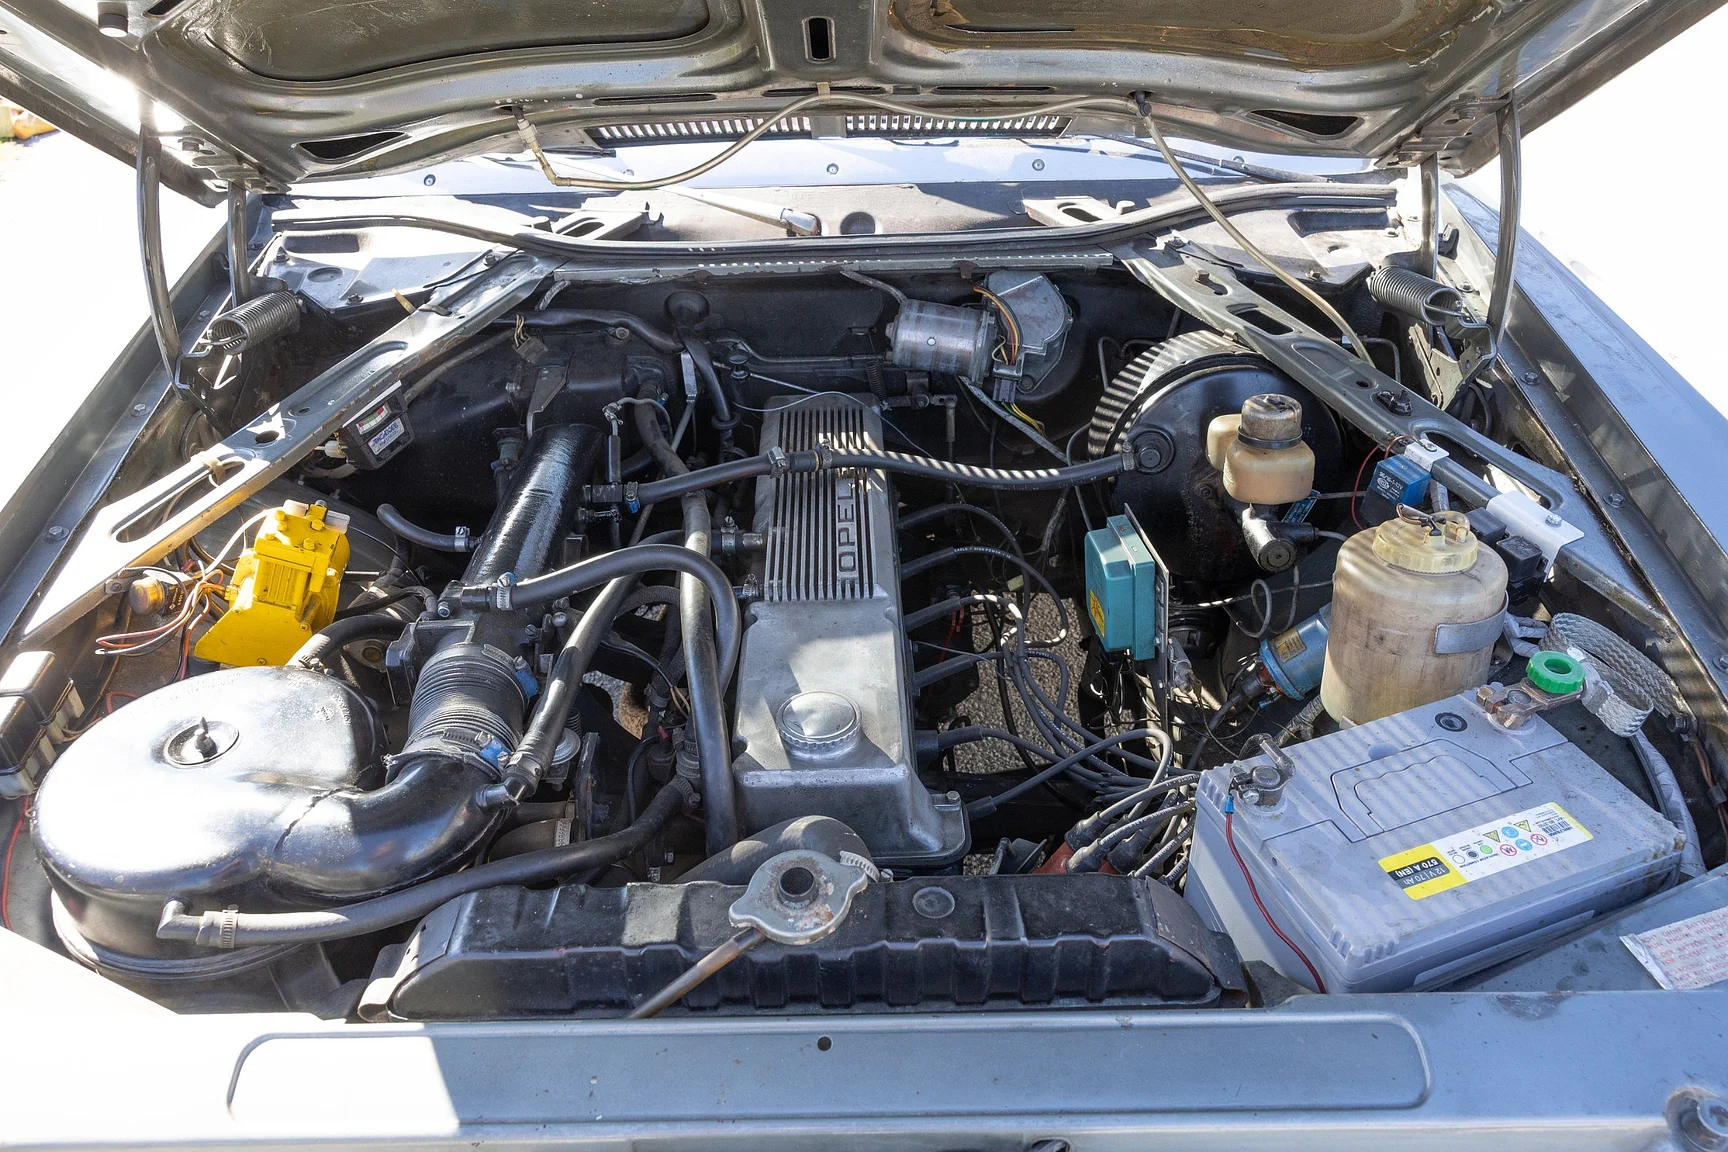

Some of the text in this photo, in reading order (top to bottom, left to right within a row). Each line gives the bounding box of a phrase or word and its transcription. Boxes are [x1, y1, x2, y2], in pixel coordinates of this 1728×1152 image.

[837, 481, 857, 573] OPEL
[1421, 859, 1439, 868] 570
[1435, 867, 1446, 875] 12
[1414, 874, 1426, 882] 70
